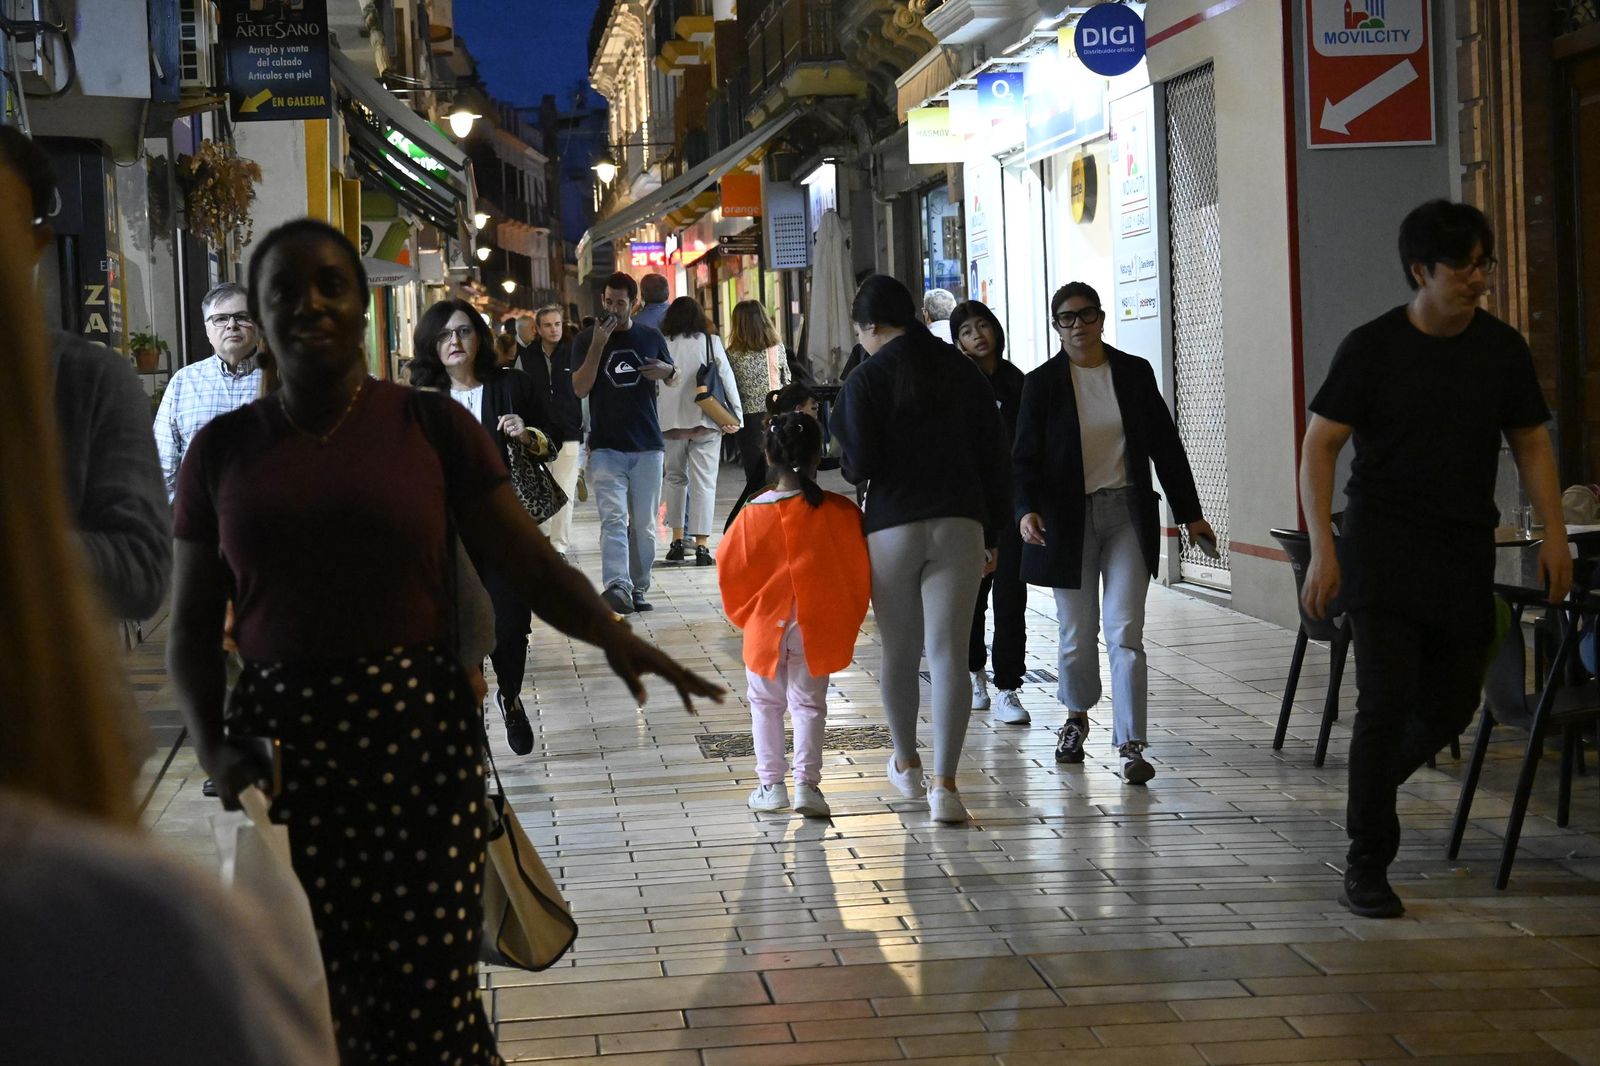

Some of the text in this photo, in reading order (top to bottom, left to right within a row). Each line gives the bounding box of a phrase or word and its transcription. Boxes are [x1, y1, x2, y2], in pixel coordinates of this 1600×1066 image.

[236, 12, 253, 23] EL
[1081, 25, 1135, 47] DIGI
[1324, 29, 1410, 45] MOVILCITY
[248, 44, 309, 55] Arreglo y venta
[1083, 47, 1115, 55] Distribuidor
[256, 57, 302, 67] del calzado
[296, 69, 312, 81] piel
[271, 95, 326, 107] EN GALERIA
[915, 129, 957, 137] MASMOV
[724, 204, 759, 216] orange
[632, 252, 647, 266] 20
